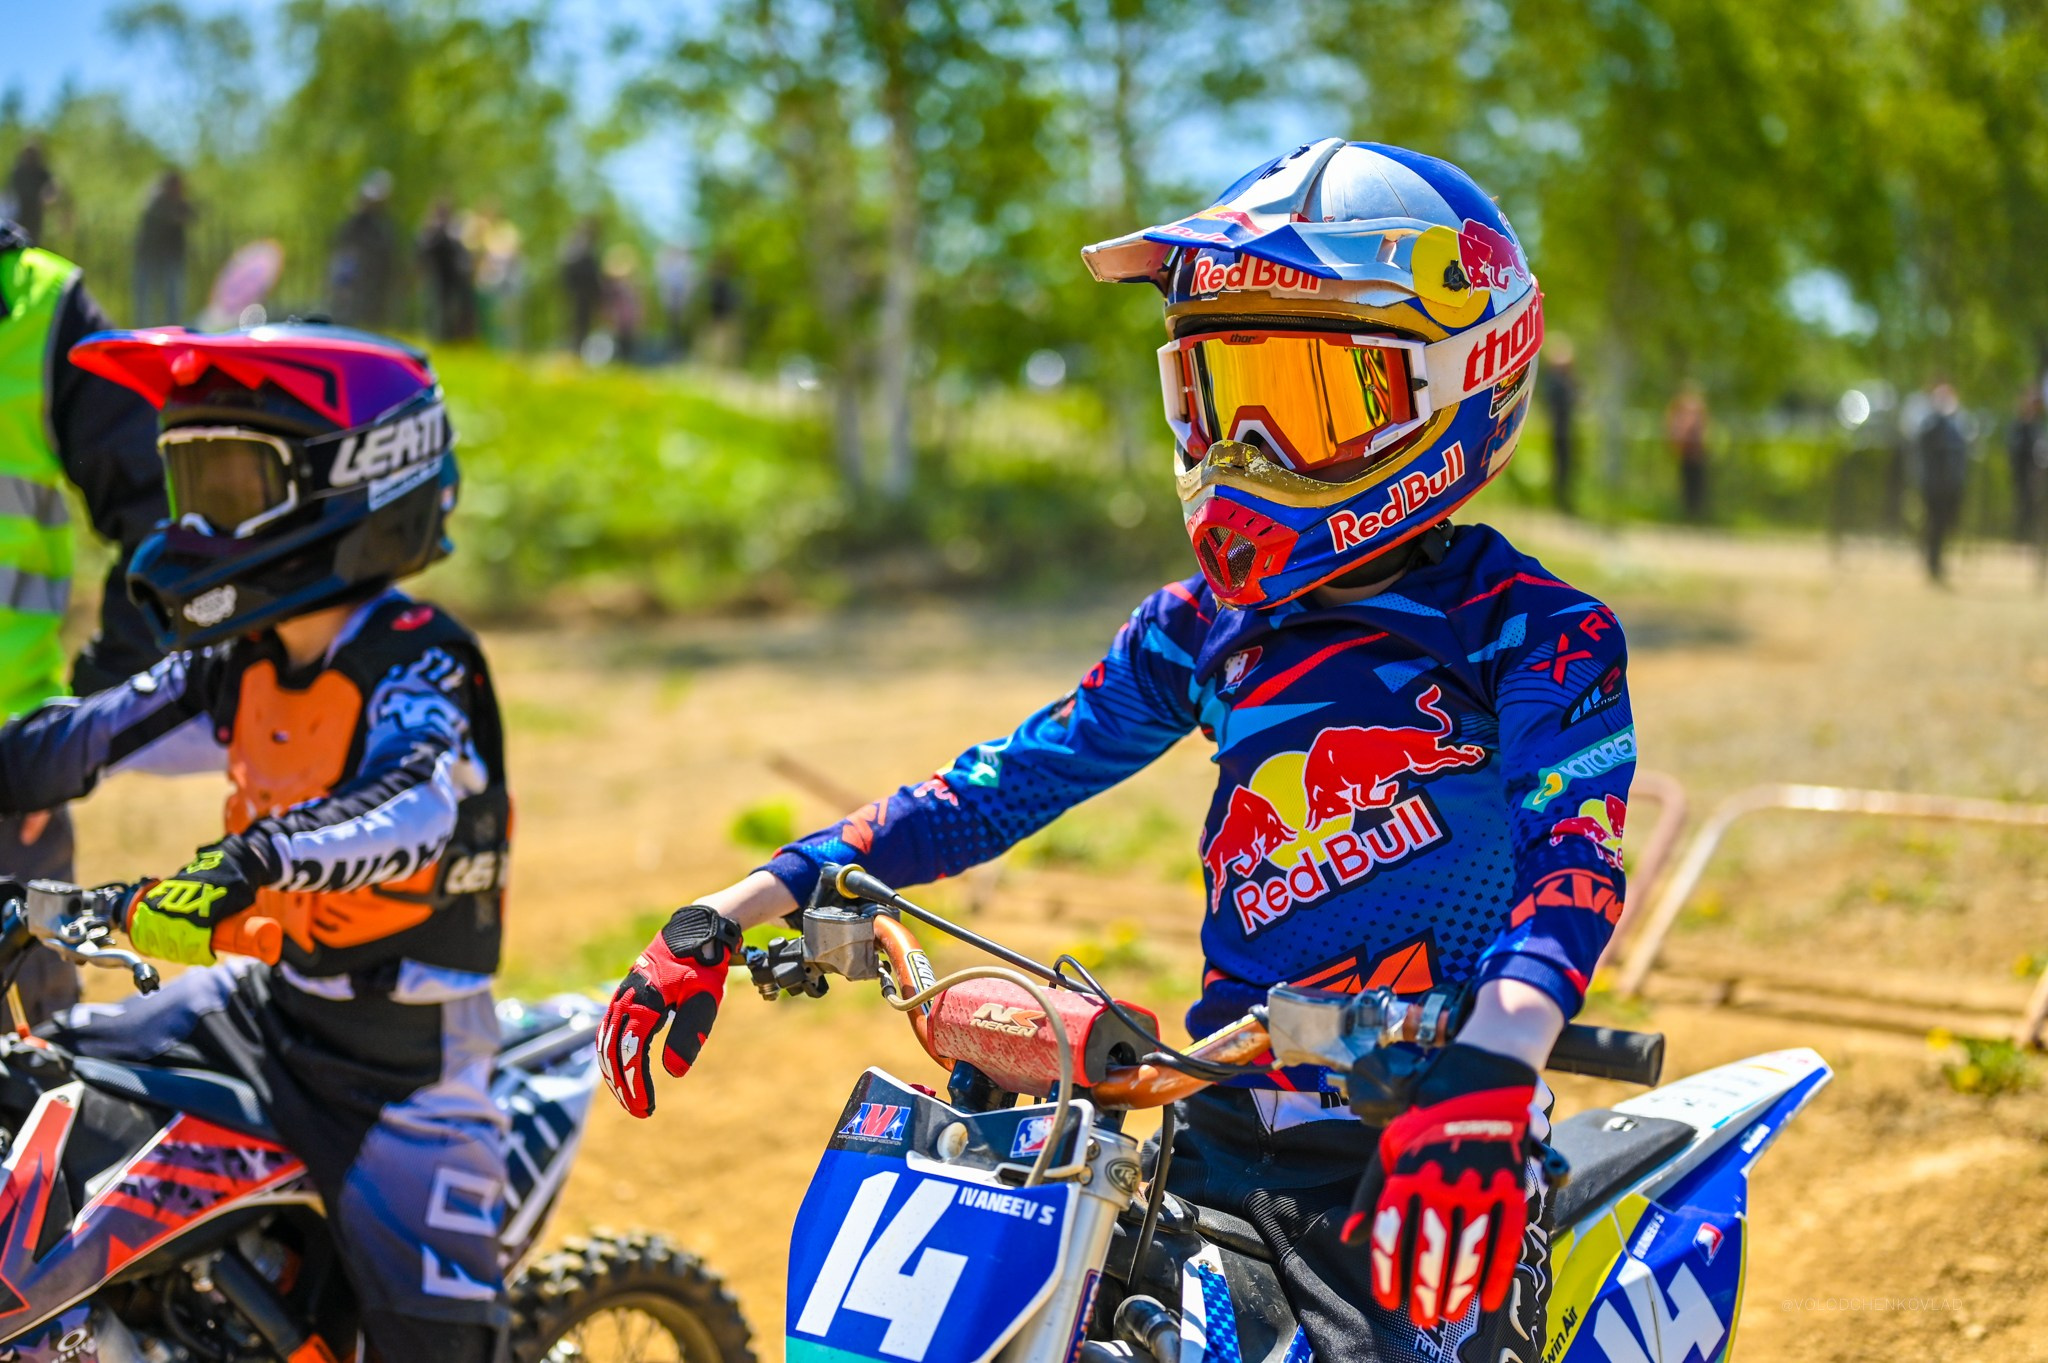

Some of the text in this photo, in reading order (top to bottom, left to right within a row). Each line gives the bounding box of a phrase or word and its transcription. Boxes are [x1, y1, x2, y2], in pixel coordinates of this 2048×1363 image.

[1190, 252, 1249, 294] Red
[1230, 333, 1256, 343] thor
[1328, 441, 1465, 553] Red Bull
[1235, 798, 1439, 930] Red Bull
[146, 880, 228, 917] FOX
[970, 1018, 1038, 1038] NEKEN
[839, 1102, 911, 1141] AMA
[958, 1186, 1057, 1226] IVANEEV S
[794, 1170, 969, 1362] 14
[1562, 1305, 1578, 1338] Air
